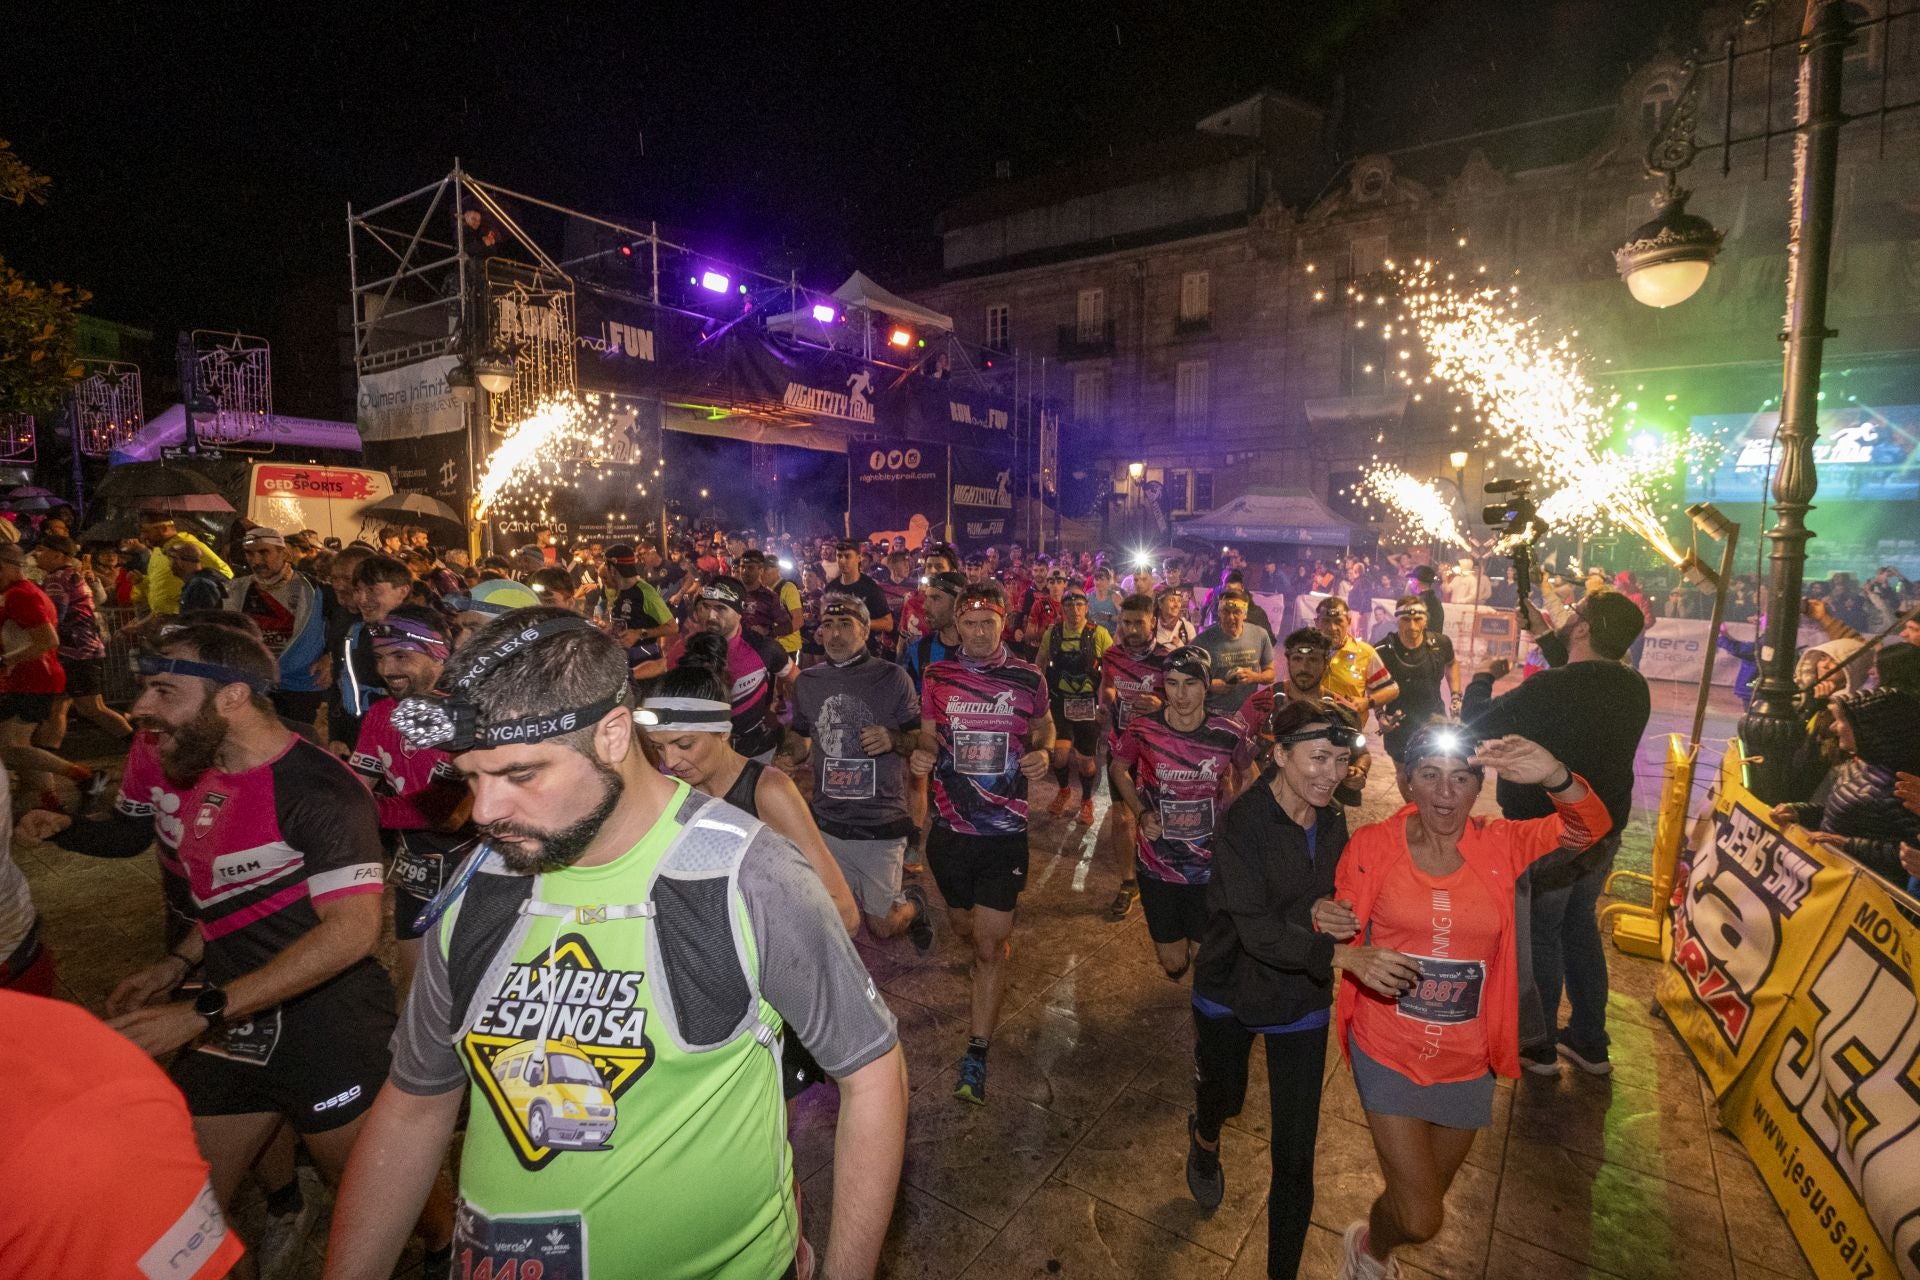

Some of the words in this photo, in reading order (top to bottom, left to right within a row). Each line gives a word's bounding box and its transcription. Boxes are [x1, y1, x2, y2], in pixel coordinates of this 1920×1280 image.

[609, 320, 654, 362] FUN
[360, 390, 407, 409] Quimera
[410, 377, 452, 400] Infinita
[783, 381, 848, 416] NIGHTCITY
[849, 400, 876, 421] TRAIL
[951, 402, 971, 424] RUN
[988, 408, 1008, 430] FUN
[263, 479, 343, 492] GEDSPORTS
[954, 484, 998, 505] NIGHTCITY
[1644, 636, 1699, 652] mera
[738, 676, 756, 689] TEAM
[946, 702, 994, 714] NIGHTCITY
[993, 705, 1014, 715] TRAIL
[827, 771, 863, 785] 2211
[1156, 769, 1199, 781] NIGHTCITY
[1199, 772, 1218, 782] TRAIL
[218, 860, 261, 878] TEAM
[1761, 843, 1819, 912] SAIZ
[492, 965, 642, 1009] TAXIBUS
[1410, 980, 1468, 1003] 1887
[472, 1000, 646, 1046] ESPINOSA
[494, 1240, 529, 1253] verde
